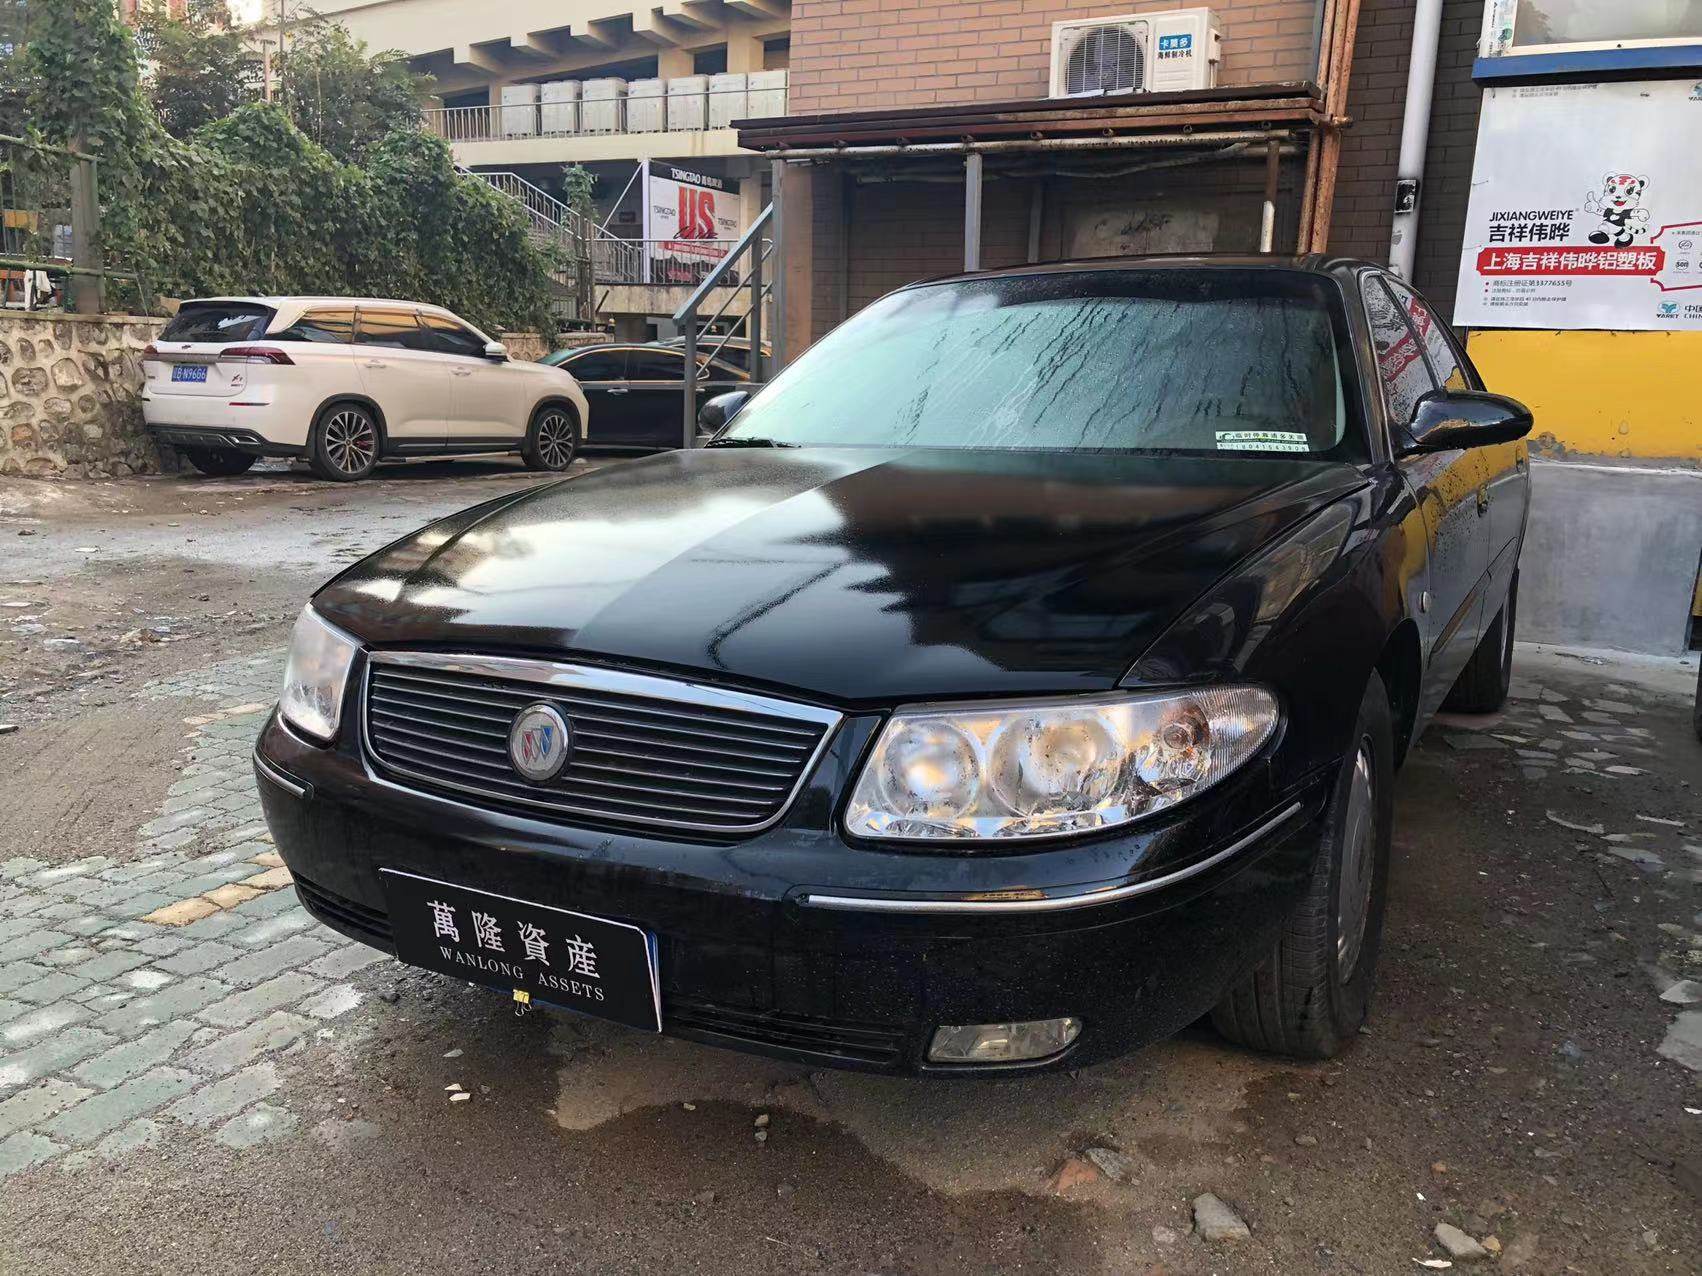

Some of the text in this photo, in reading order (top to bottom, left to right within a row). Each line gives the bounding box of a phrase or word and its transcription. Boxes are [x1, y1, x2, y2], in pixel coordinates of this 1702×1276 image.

[671, 168, 700, 183] TSINGTAO
[1489, 208, 1574, 223] JIXIANGWEIYE
[1488, 223, 1571, 243] 吉祥伟晔
[1483, 250, 1658, 271] 上海吉祥伟晔铝塑板
[439, 945, 606, 1002] WANLONG ASSETS
